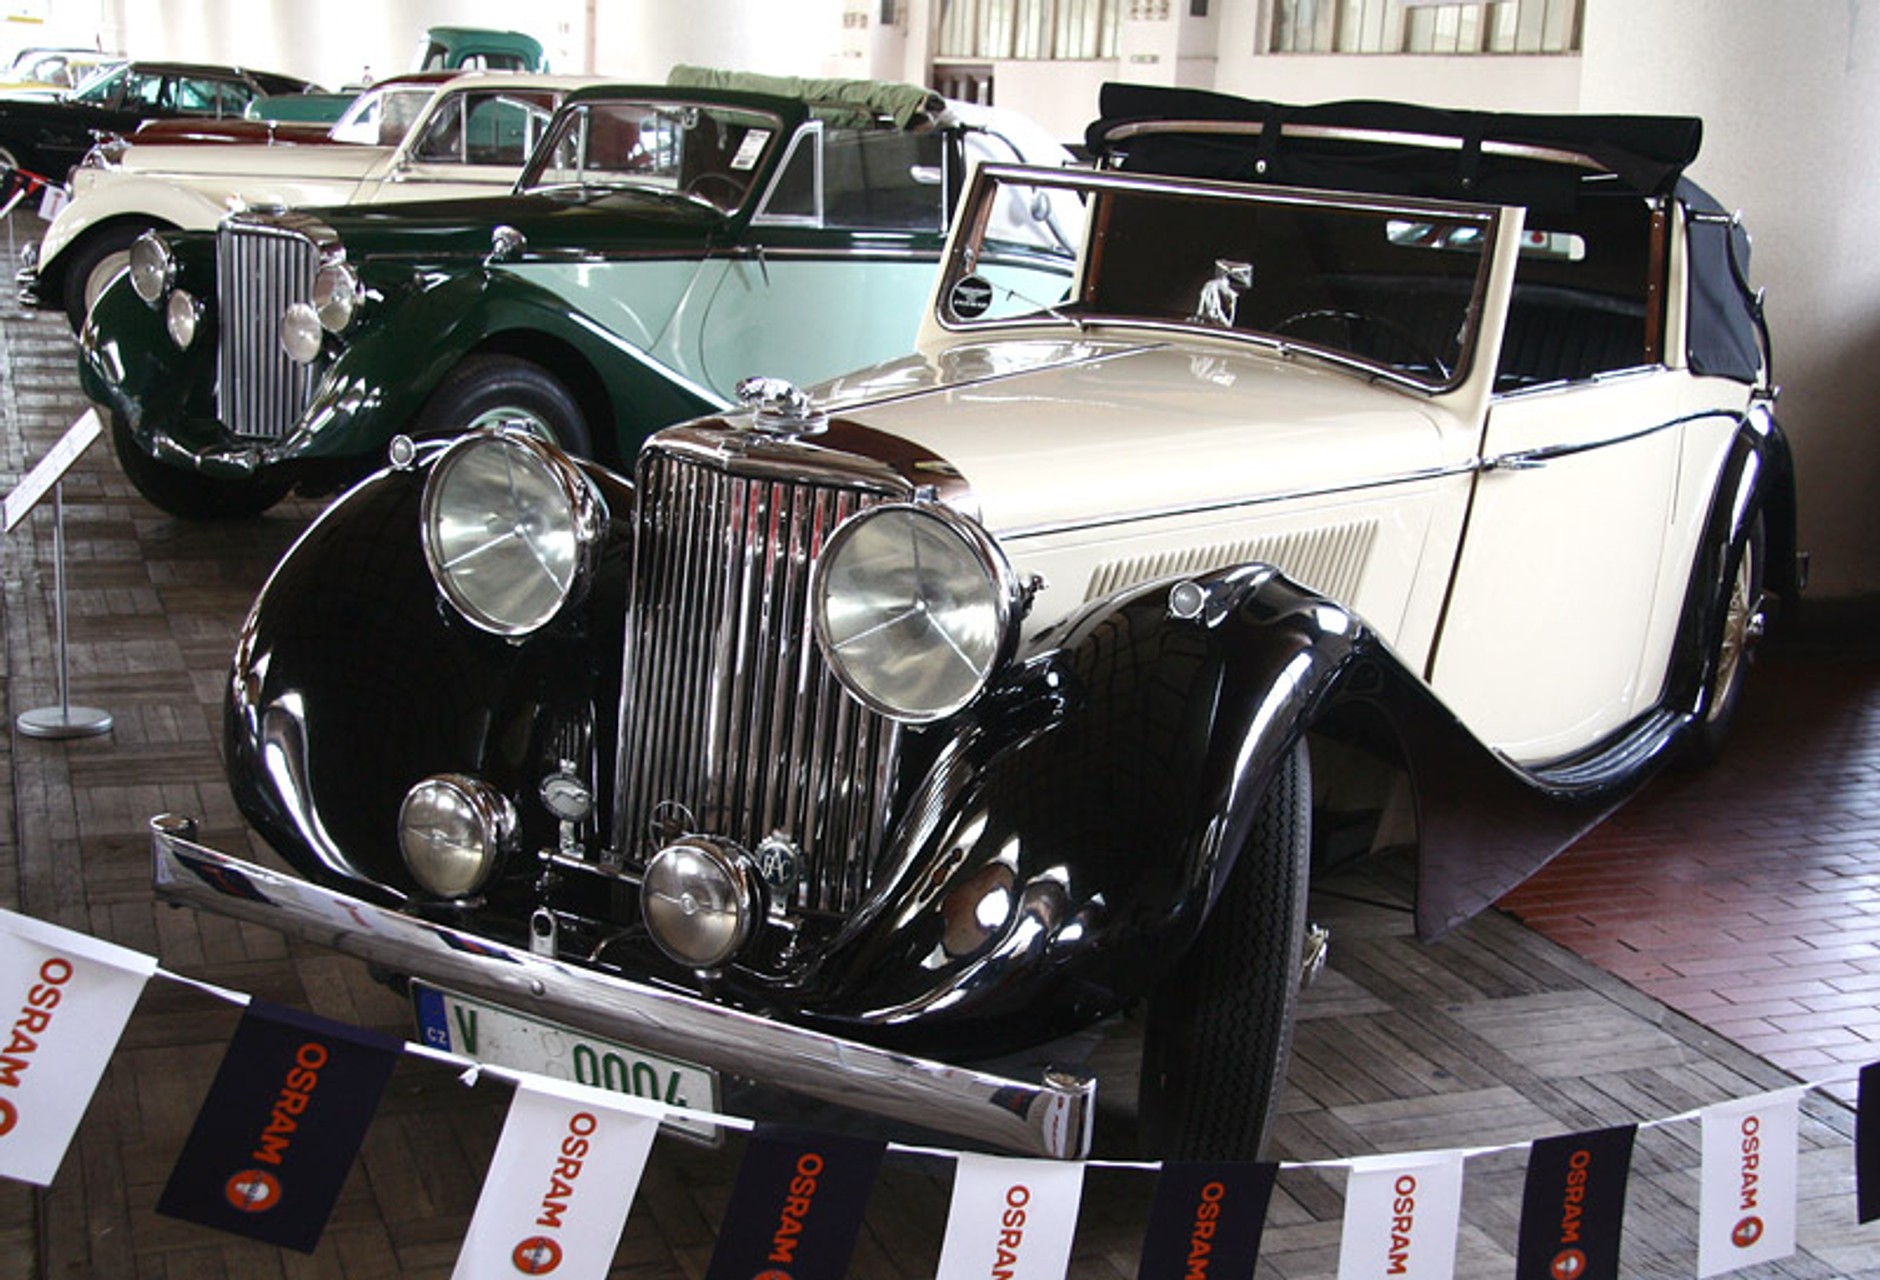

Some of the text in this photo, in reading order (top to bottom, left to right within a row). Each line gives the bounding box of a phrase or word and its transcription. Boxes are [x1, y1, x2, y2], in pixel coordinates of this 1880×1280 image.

[0, 957, 73, 1089] OSRAM
[427, 1026, 447, 1044] CZ
[454, 1004, 693, 1110] V 0004
[253, 1043, 327, 1165] OSRAM
[536, 1112, 598, 1229] OSRAM
[768, 1153, 823, 1263] OSRAM
[1560, 1150, 1591, 1243] OSRAM
[1740, 1116, 1761, 1210] OSRAM
[1184, 1182, 1225, 1280] OSRAM
[1386, 1174, 1416, 1276] OSRAM
